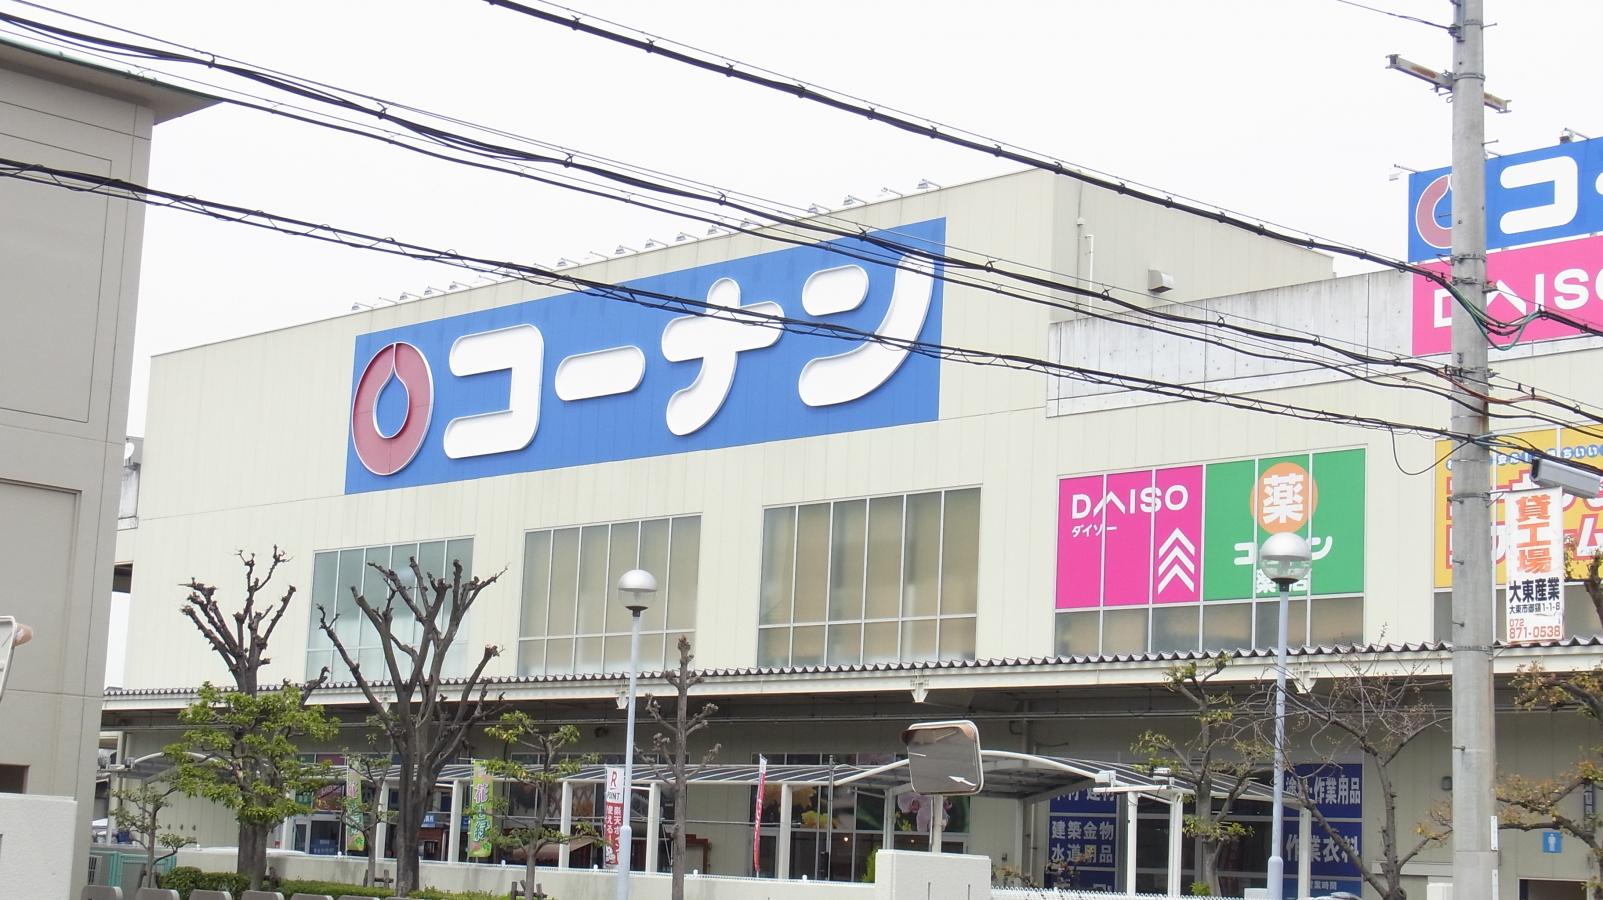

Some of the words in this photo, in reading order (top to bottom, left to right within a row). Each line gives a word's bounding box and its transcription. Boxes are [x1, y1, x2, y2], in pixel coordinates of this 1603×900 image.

[1500, 155, 1603, 235] コ
[1434, 267, 1603, 329] DAIS
[443, 253, 935, 459] コーナン
[1071, 484, 1189, 519] DAISO
[1262, 473, 1304, 523] 薬
[1072, 523, 1118, 538] ダイソー
[1515, 494, 1553, 574] 貸工場
[1233, 535, 1333, 566] コン
[1509, 576, 1560, 604] 大東産業
[1509, 618, 1525, 627] 072
[1051, 820, 1115, 841] 建築金物
[1051, 843, 1113, 864] 水道用品
